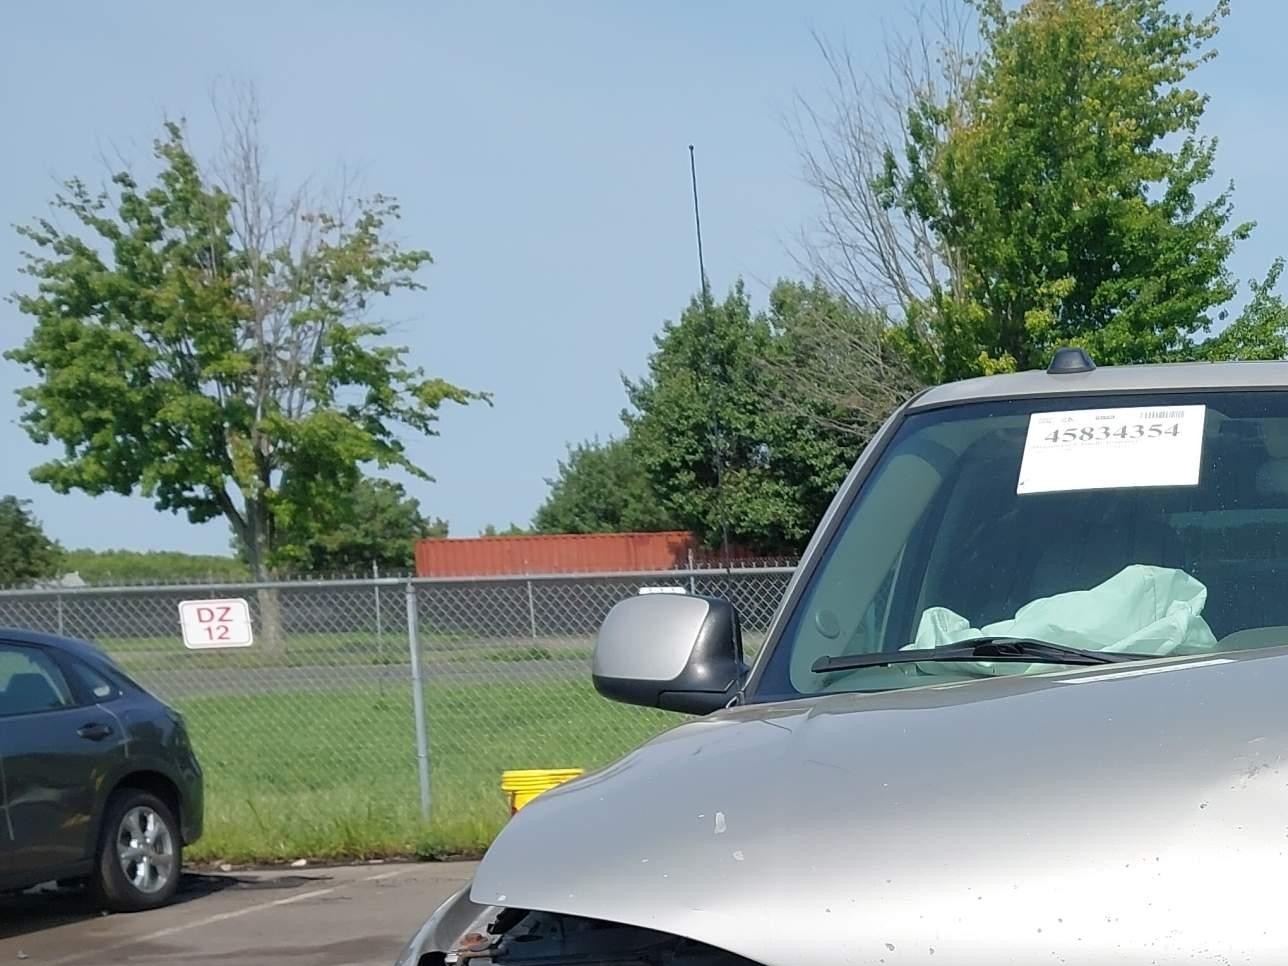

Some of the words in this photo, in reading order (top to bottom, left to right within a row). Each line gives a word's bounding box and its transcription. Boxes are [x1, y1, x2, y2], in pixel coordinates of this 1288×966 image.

[1043, 423, 1181, 444] 45834354
[196, 606, 233, 623] DZ
[204, 625, 231, 640] 12
